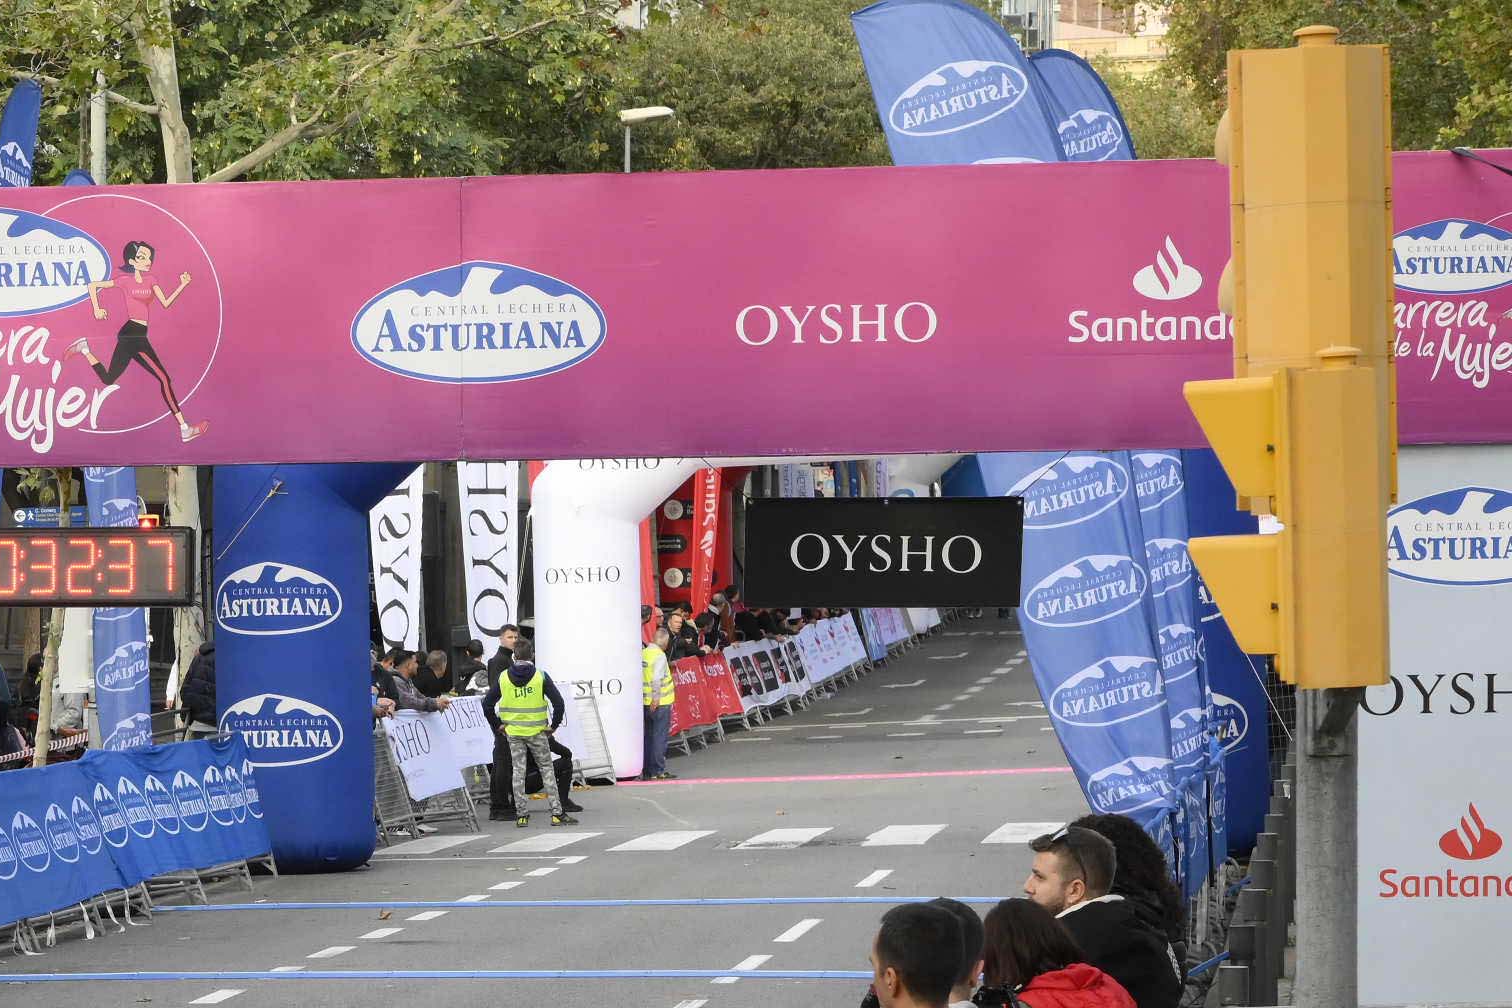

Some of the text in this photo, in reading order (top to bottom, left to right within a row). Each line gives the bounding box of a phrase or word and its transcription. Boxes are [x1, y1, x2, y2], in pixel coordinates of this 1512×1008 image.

[14, 244, 86, 255] LECHERA
[1407, 245, 1457, 253] CENTRAL
[410, 301, 579, 318] CENTRAL LECHERA
[371, 309, 587, 353] ASTURIANA
[735, 301, 938, 346] OYSHO
[1417, 328, 1435, 357] la
[1414, 521, 1483, 533] CENTRAL
[789, 532, 983, 574] OYSHO
[545, 565, 621, 585] OYSHO
[232, 586, 328, 596] CENTRAL LECHERA
[219, 591, 333, 620] ASTURIANA
[514, 686, 533, 698] Life
[234, 718, 329, 727] CENTRAL LECHERA
